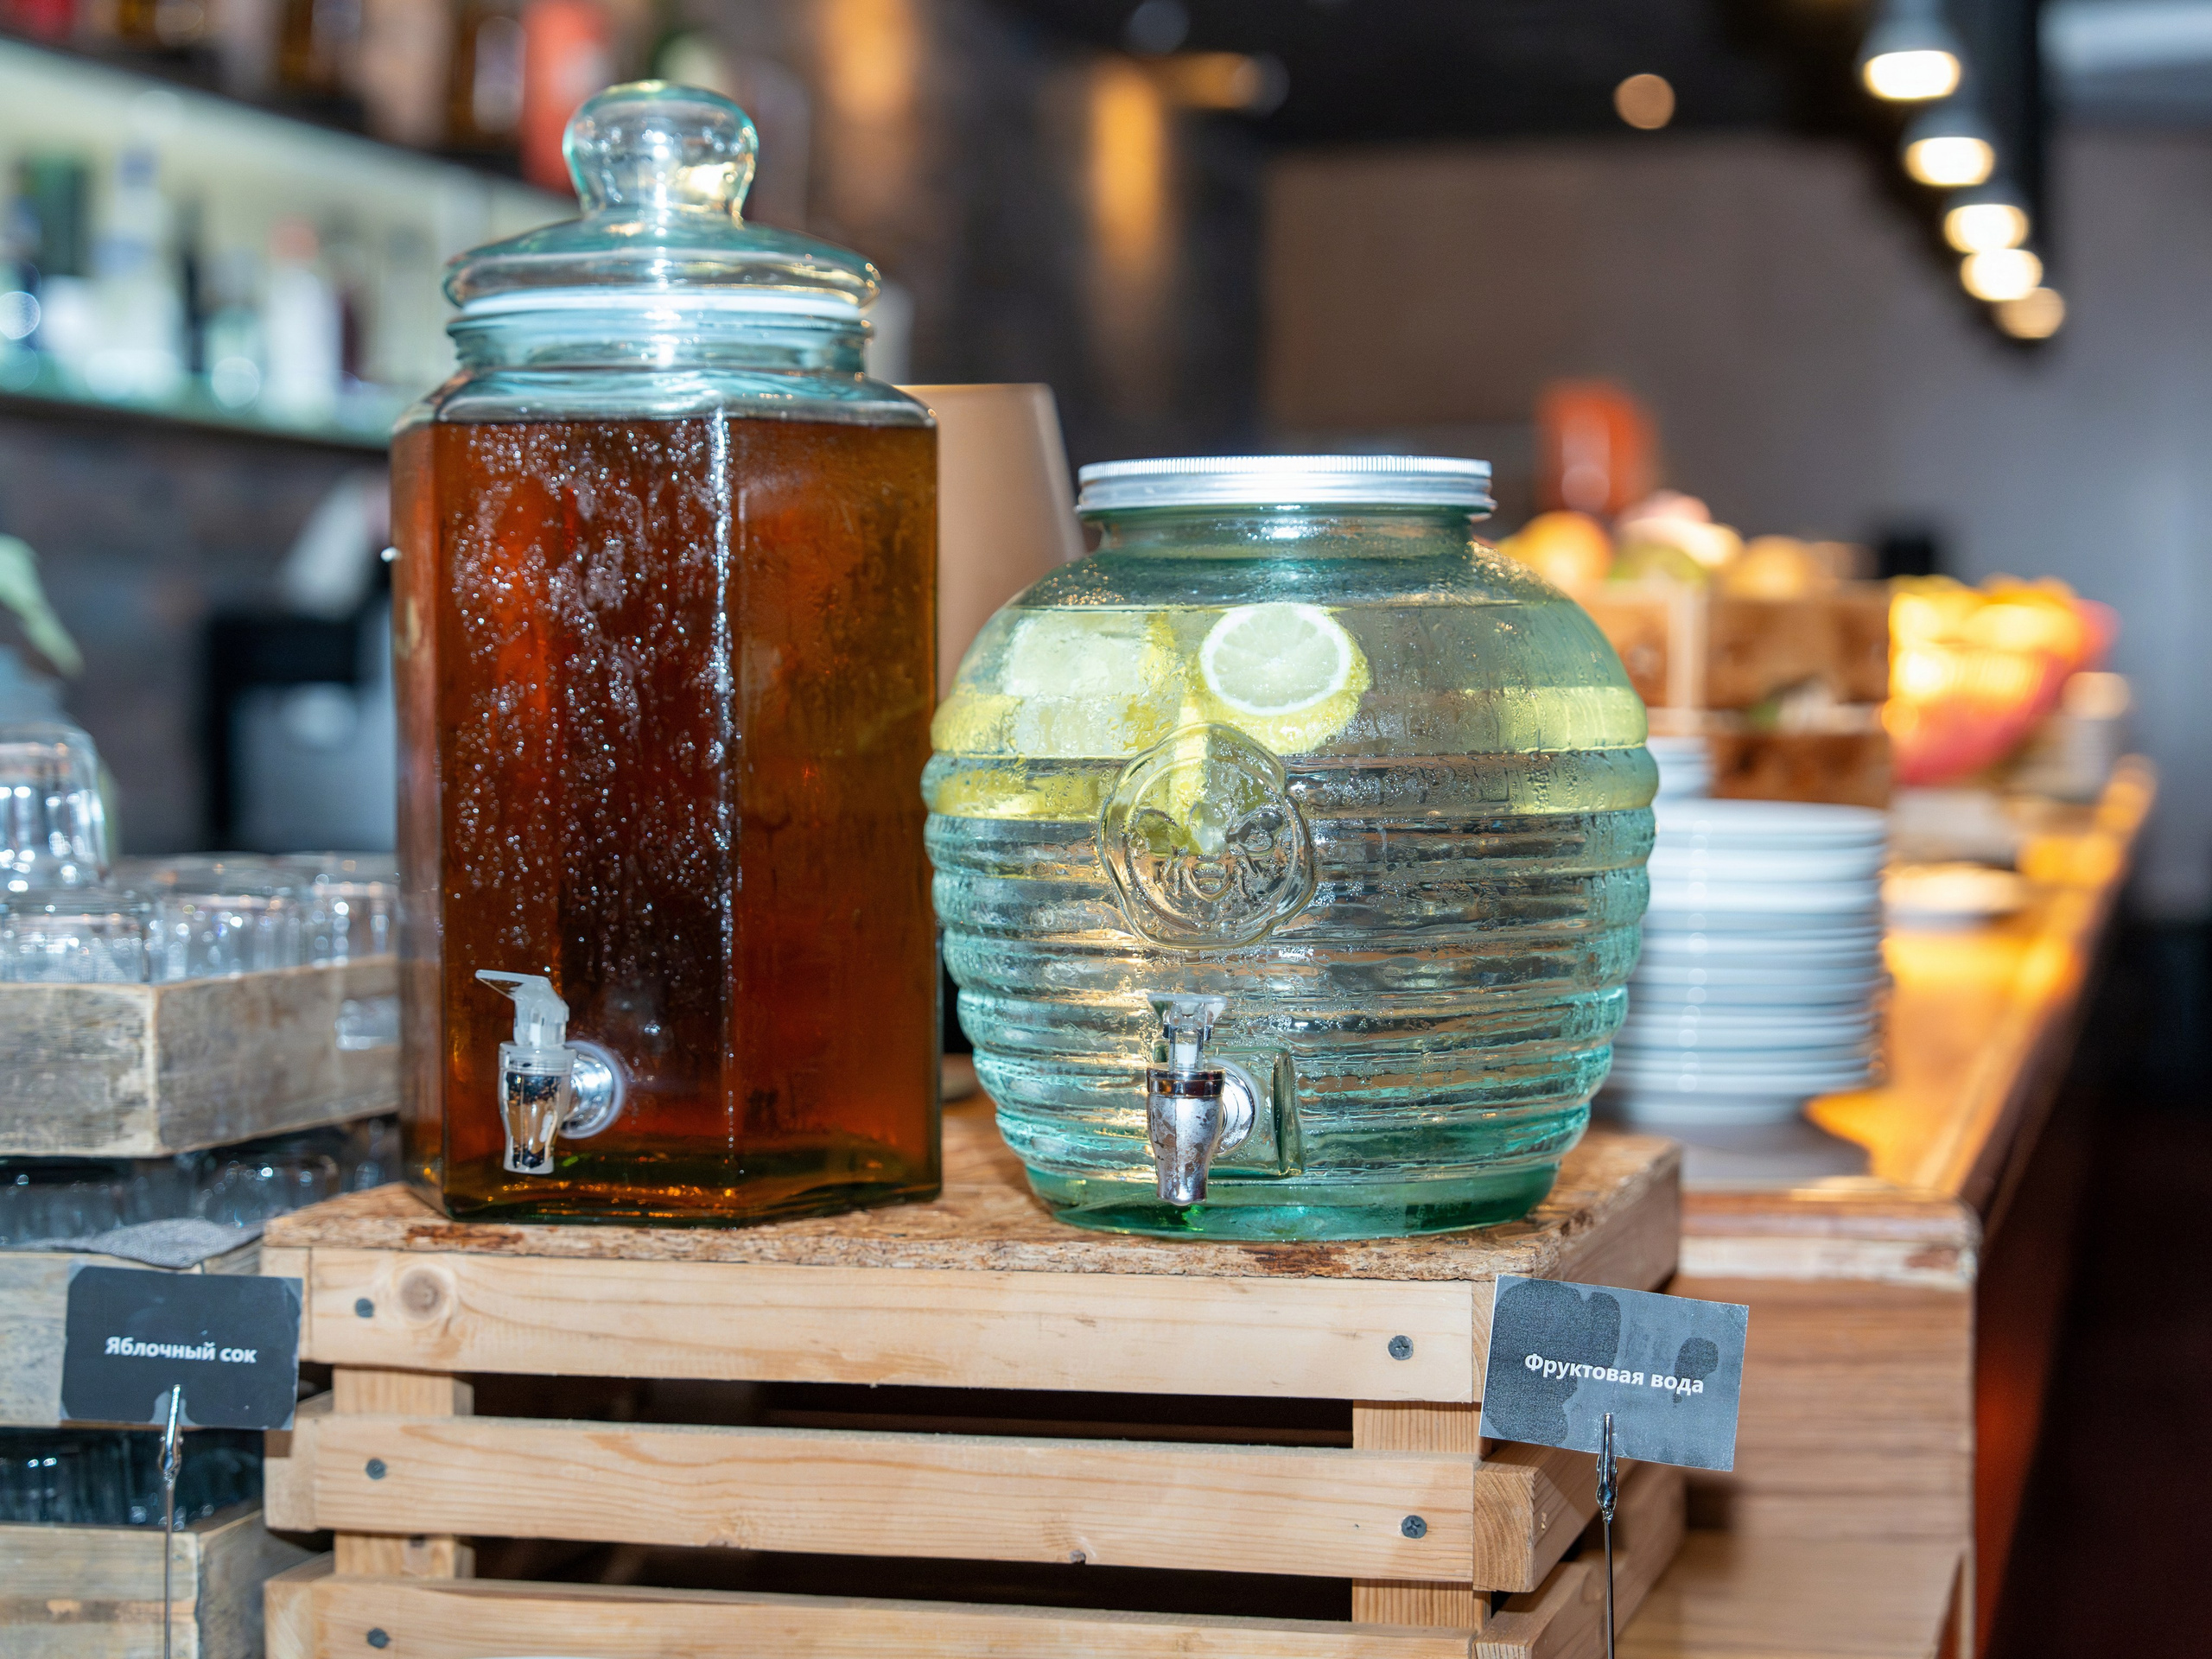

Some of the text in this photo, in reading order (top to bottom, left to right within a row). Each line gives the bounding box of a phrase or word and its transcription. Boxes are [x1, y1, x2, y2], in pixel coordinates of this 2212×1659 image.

[104, 1336, 257, 1363] Яблочный сок
[1524, 1353, 1704, 1395] Фруктовая вода
